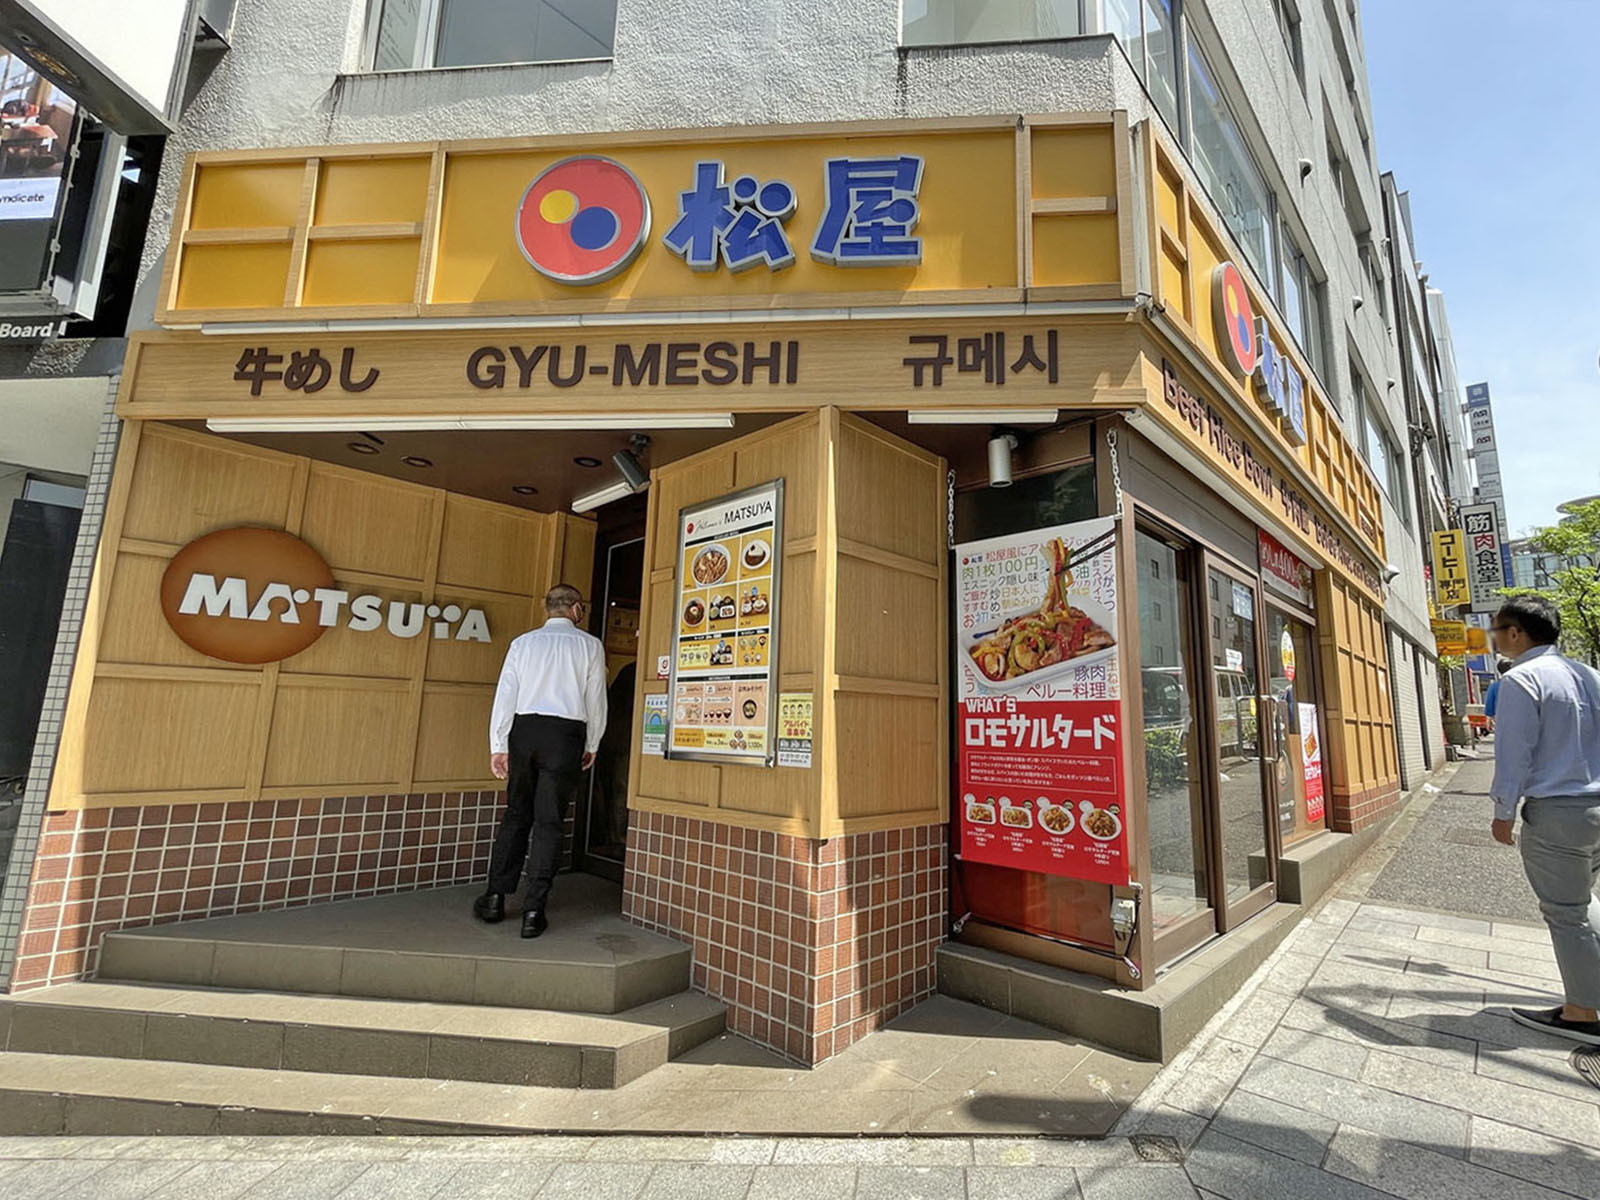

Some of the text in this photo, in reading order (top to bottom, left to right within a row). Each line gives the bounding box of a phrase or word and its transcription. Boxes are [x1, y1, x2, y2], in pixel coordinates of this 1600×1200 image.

[662, 155, 925, 273] 松屋
[0, 322, 54, 338] Board
[233, 347, 380, 397] 牛めし
[466, 340, 799, 389] GYU-MESHI
[903, 329, 1058, 387] 규메시
[724, 501, 773, 525] MATSUYA
[962, 556, 1039, 580] 肉1枚100円
[178, 573, 492, 643] MATSUYA
[1073, 665, 1106, 682] 豚肉
[965, 695, 1017, 713] WHAT'S
[1026, 682, 1107, 700] ペルー料理
[965, 714, 1116, 750] ロモサルタード
